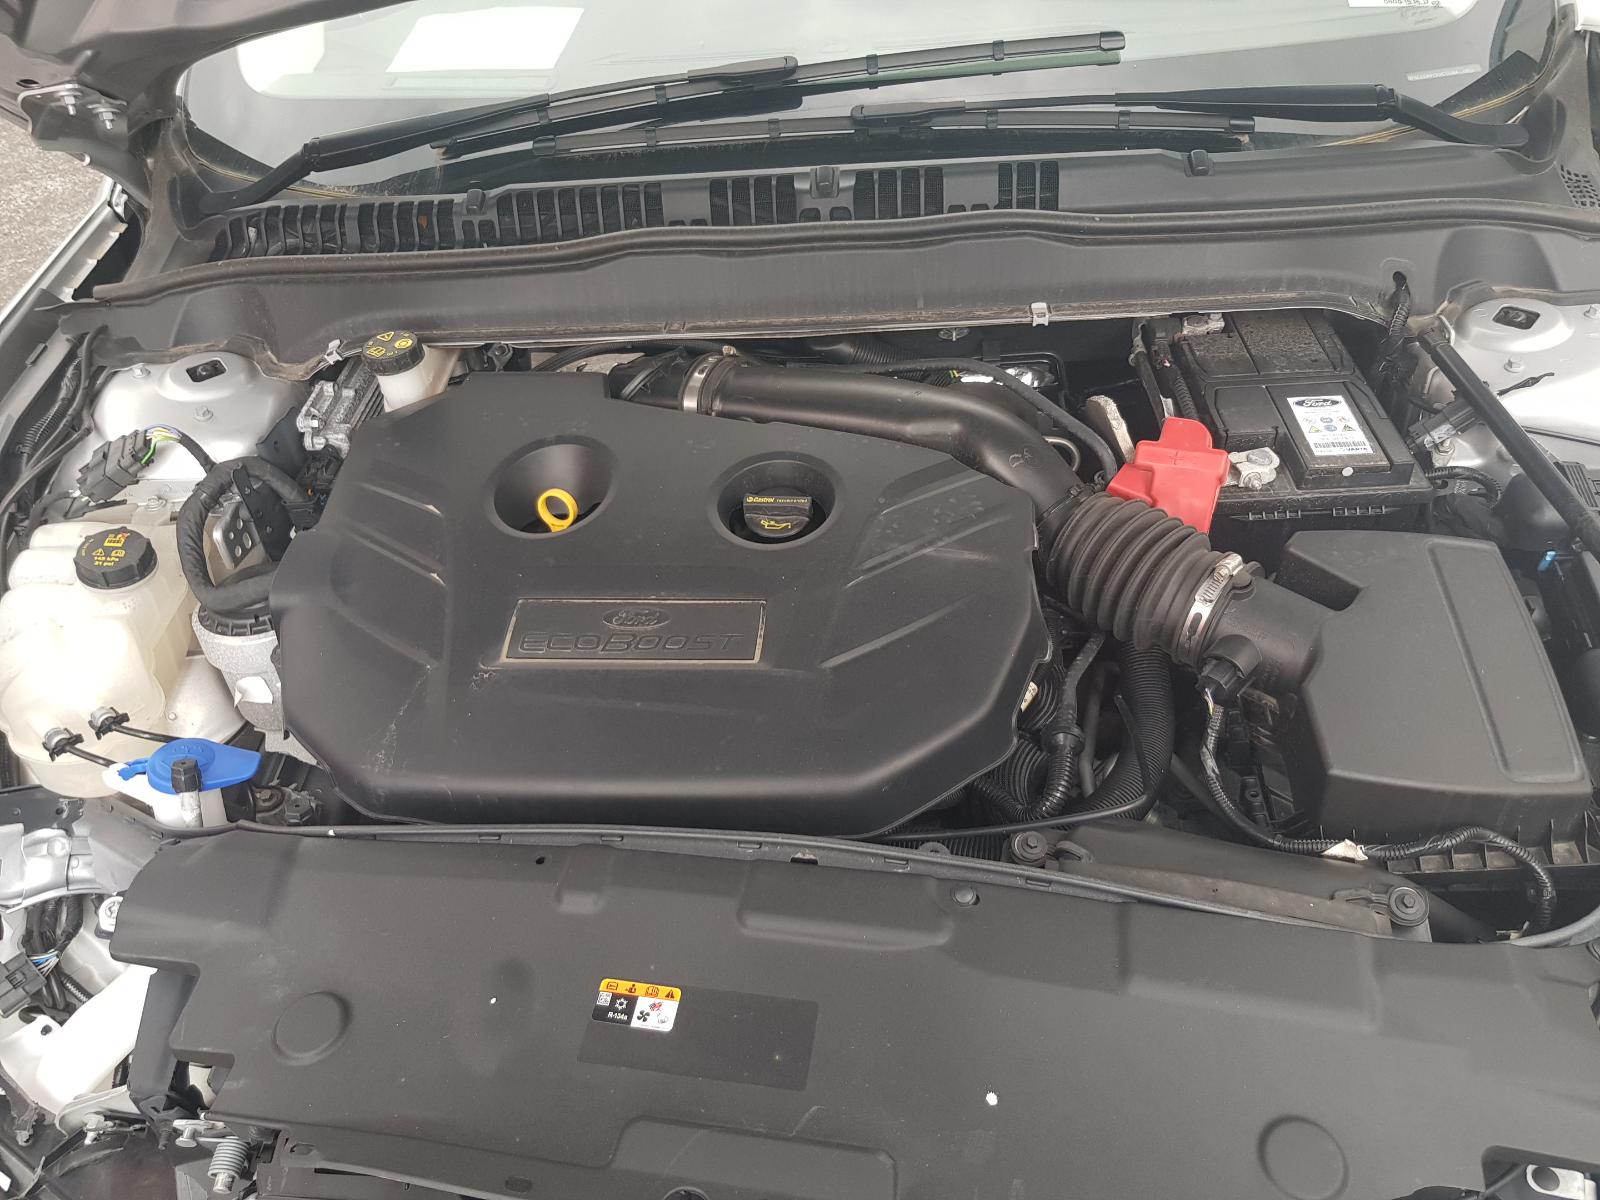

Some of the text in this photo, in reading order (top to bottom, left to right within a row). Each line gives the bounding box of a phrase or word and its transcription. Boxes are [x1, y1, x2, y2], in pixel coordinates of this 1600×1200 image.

[1303, 399, 1333, 407] Ford
[612, 610, 660, 626] Ford
[519, 631, 745, 654] ECOBOOST
[607, 1011, 628, 1021] R-134a
